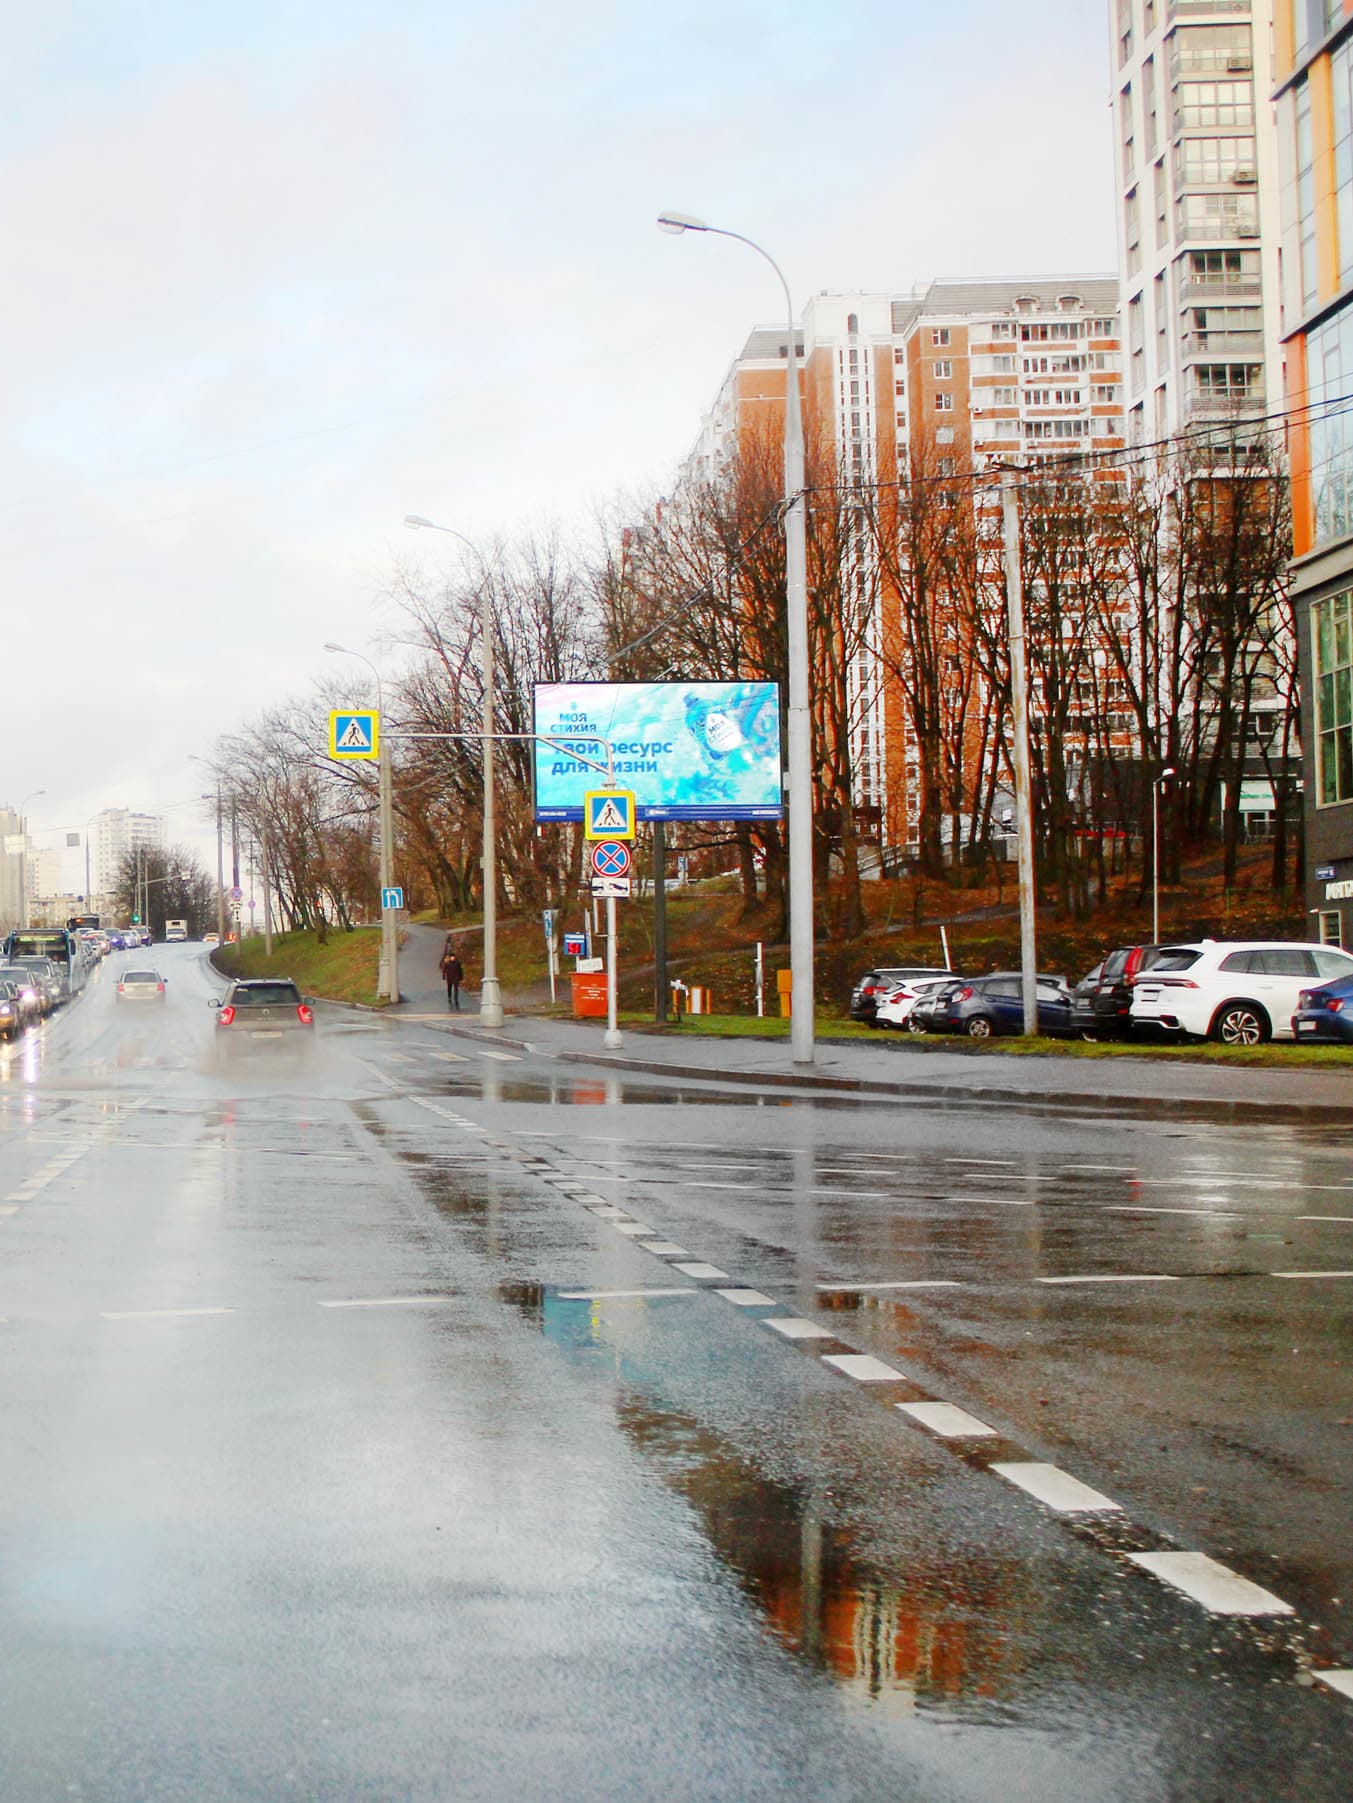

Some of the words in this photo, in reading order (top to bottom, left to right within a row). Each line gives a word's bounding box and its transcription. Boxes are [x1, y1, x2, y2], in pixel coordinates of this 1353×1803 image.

[559, 713, 588, 722] МОЯ
[550, 723, 597, 733] СТИХИЯ
[552, 740, 599, 755] вой
[551, 761, 589, 776] для
